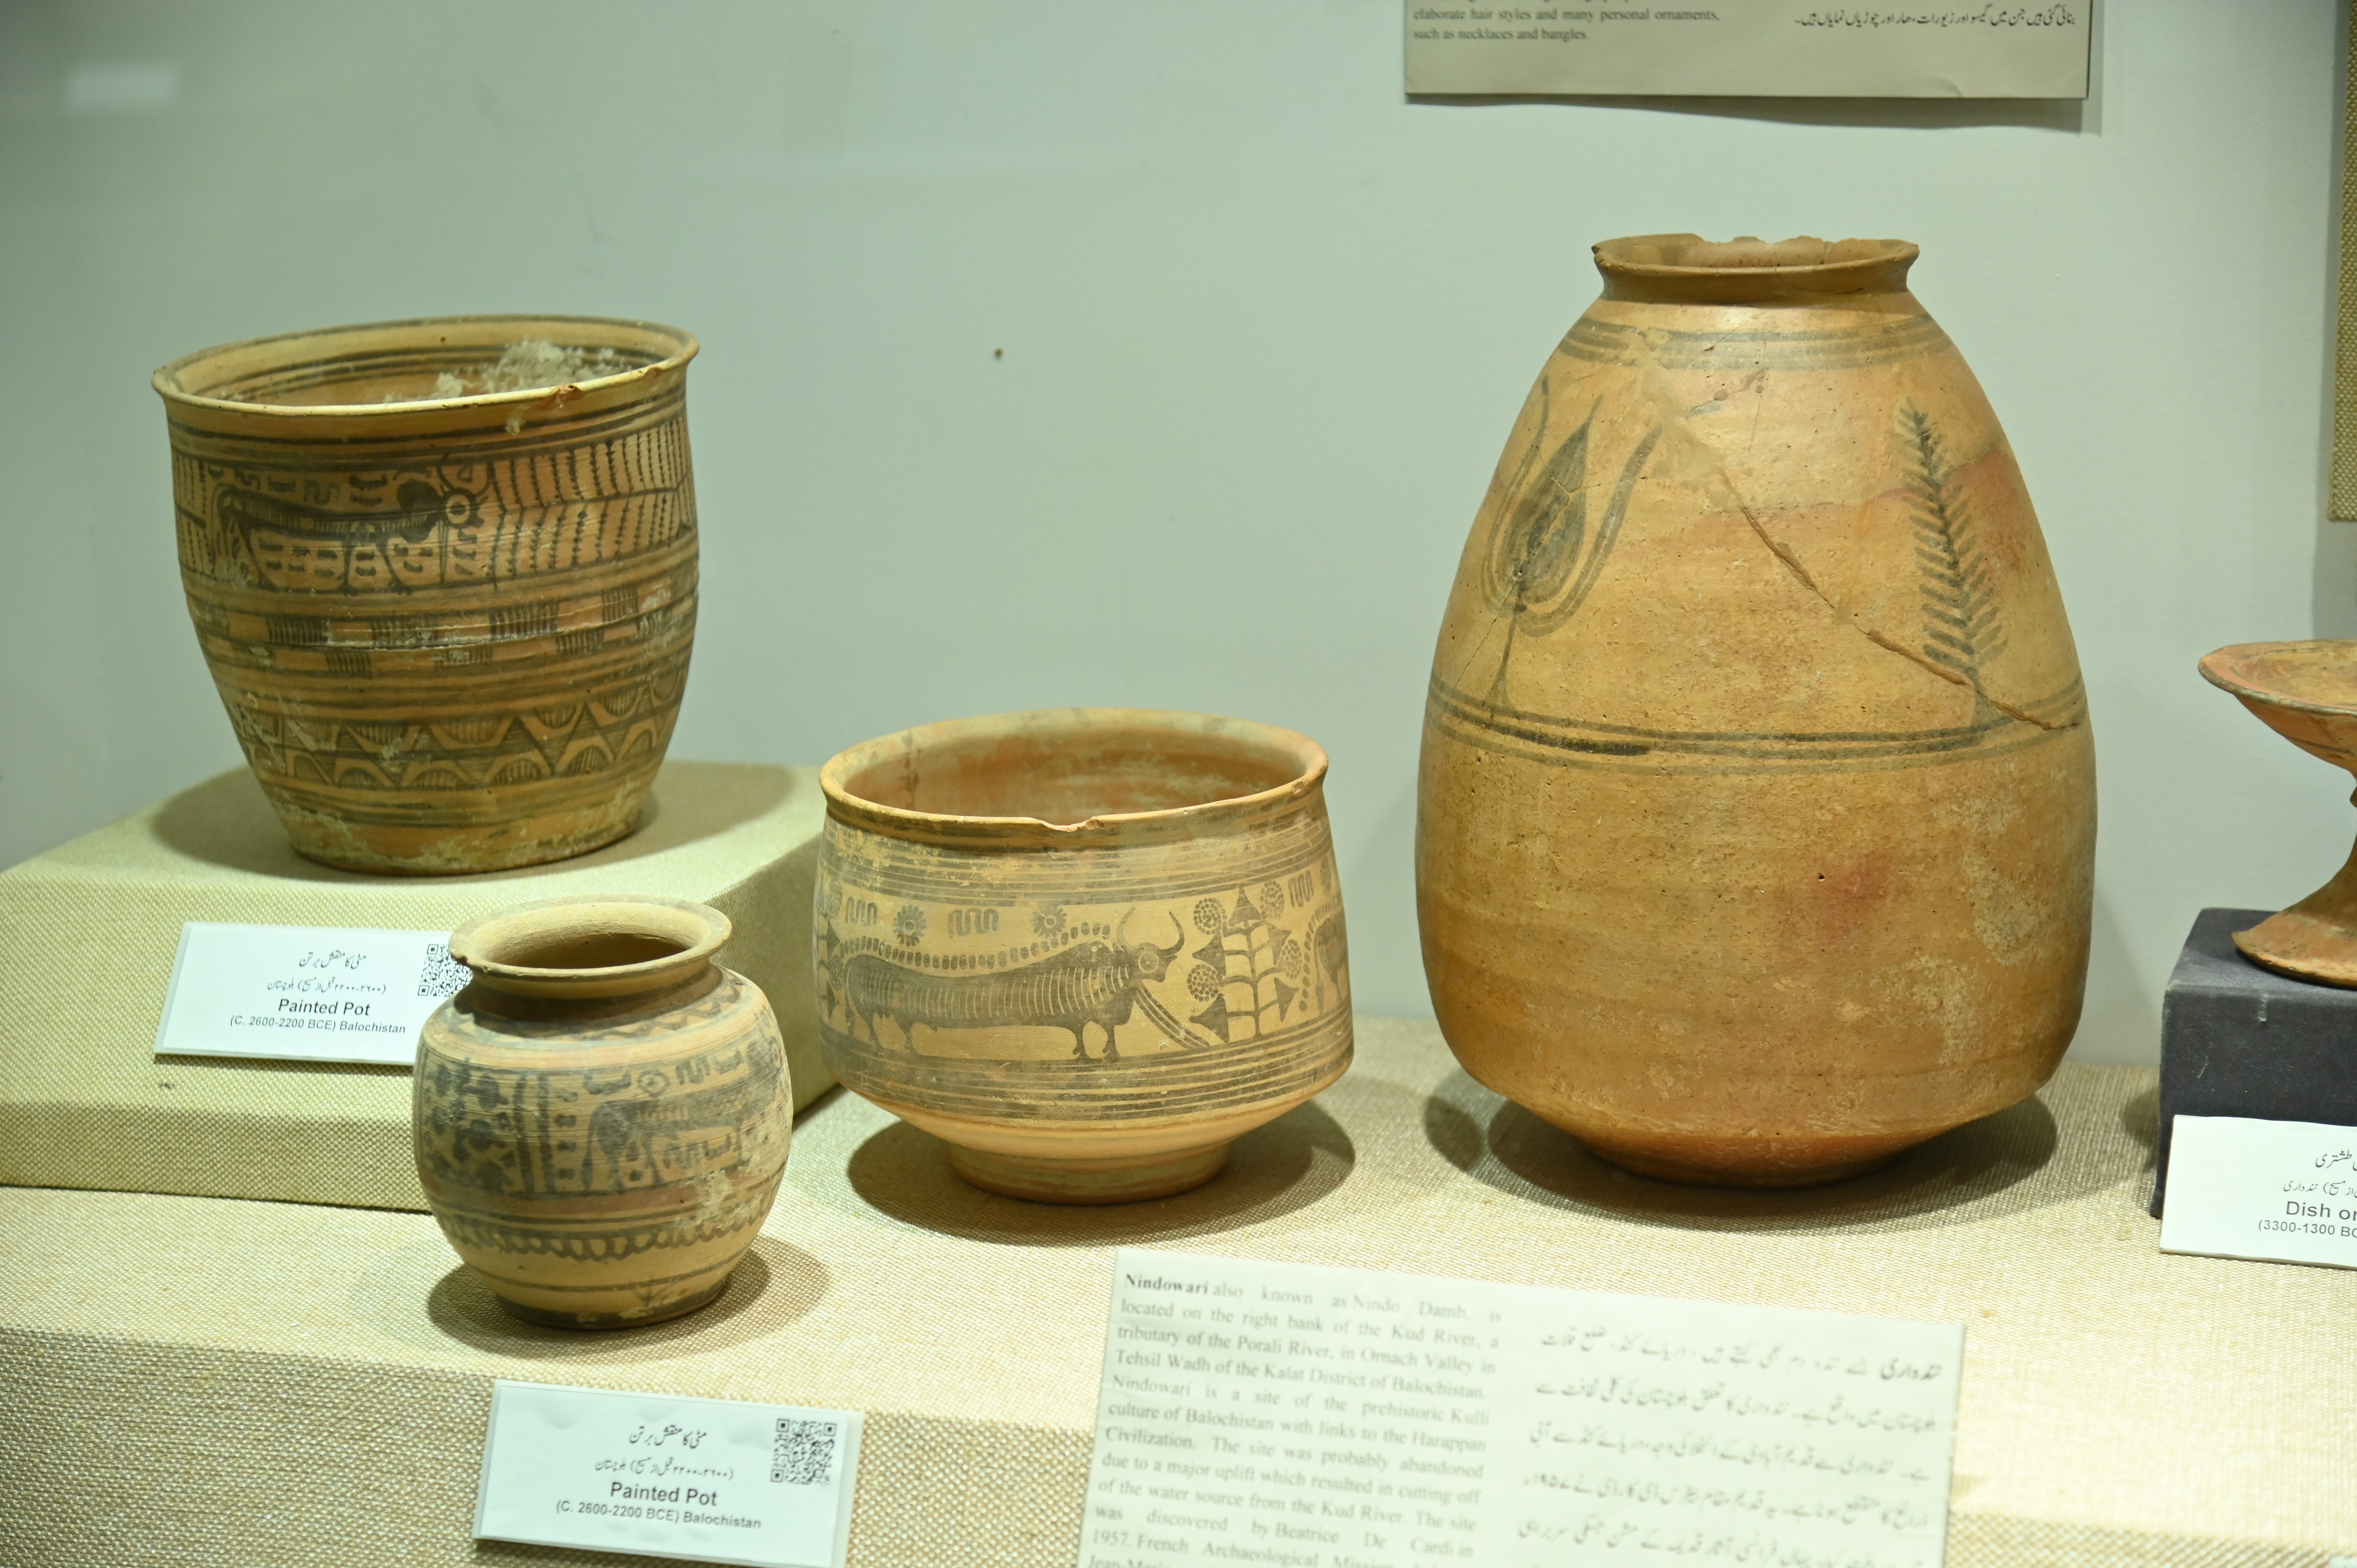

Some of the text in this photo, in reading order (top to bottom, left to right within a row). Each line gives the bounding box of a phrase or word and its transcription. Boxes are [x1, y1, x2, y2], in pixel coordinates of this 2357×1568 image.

[1413, 8, 1720, 23] elaborate hair styles and many personal ornaments,
[1413, 28, 1588, 43] such as necklaces and bangles.
[230, 1015, 406, 1033] (C. 2600-2200 BCE) Balochistan
[278, 998, 370, 1016] Painted Pot
[2258, 1219, 2336, 1235] (3300-1300
[2286, 1201, 2331, 1218] Dish
[1125, 1273, 1208, 1294] Nindowari
[1212, 1282, 1244, 1298] also
[1261, 1286, 1313, 1305] known
[1331, 1296, 1347, 1308] as
[1353, 1294, 1400, 1312] Nindo
[1489, 1311, 1502, 1323] is
[1121, 1298, 1499, 1349] located on the right bank of the Kud River, a
[1117, 1321, 1182, 1347] tributary
[1186, 1331, 1206, 1346] of
[1208, 1333, 1232, 1349] the
[1237, 1335, 1282, 1354] Porali
[1288, 1340, 1334, 1360] River,
[1340, 1344, 1355, 1360] in
[1424, 1353, 1472, 1376] Valley
[1481, 1359, 1496, 1374] in
[1116, 1349, 1161, 1367] Tehsil
[1167, 1354, 1210, 1372] Wadh
[1214, 1359, 1235, 1375] of
[1236, 1360, 1259, 1377] the
[1264, 1363, 1304, 1381] Kalat
[1309, 1367, 1366, 1388] District
[1369, 1374, 1390, 1390] of
[1112, 1374, 1489, 1426] Nindowari is a site of the prehistoric Kulli
[1108, 1401, 1486, 1454] culture of Balochistan with links to the Harappan
[1105, 1426, 1484, 1479] Civilization. The site was probably abandoned
[610, 1481, 717, 1506] Painted Pot
[1101, 1451, 1482, 1506] due to a major uplift which resulted in cutting off
[556, 1500, 762, 1529] (C. 2600-2200 BCE) Balochistan
[1097, 1478, 1477, 1532] of the water source from the Kud River. The site
[1093, 1528, 1131, 1548] 1957.
[1137, 1533, 1189, 1554] French
[1095, 1506, 1474, 1558] was discovered by Beatrice De Cardi in
